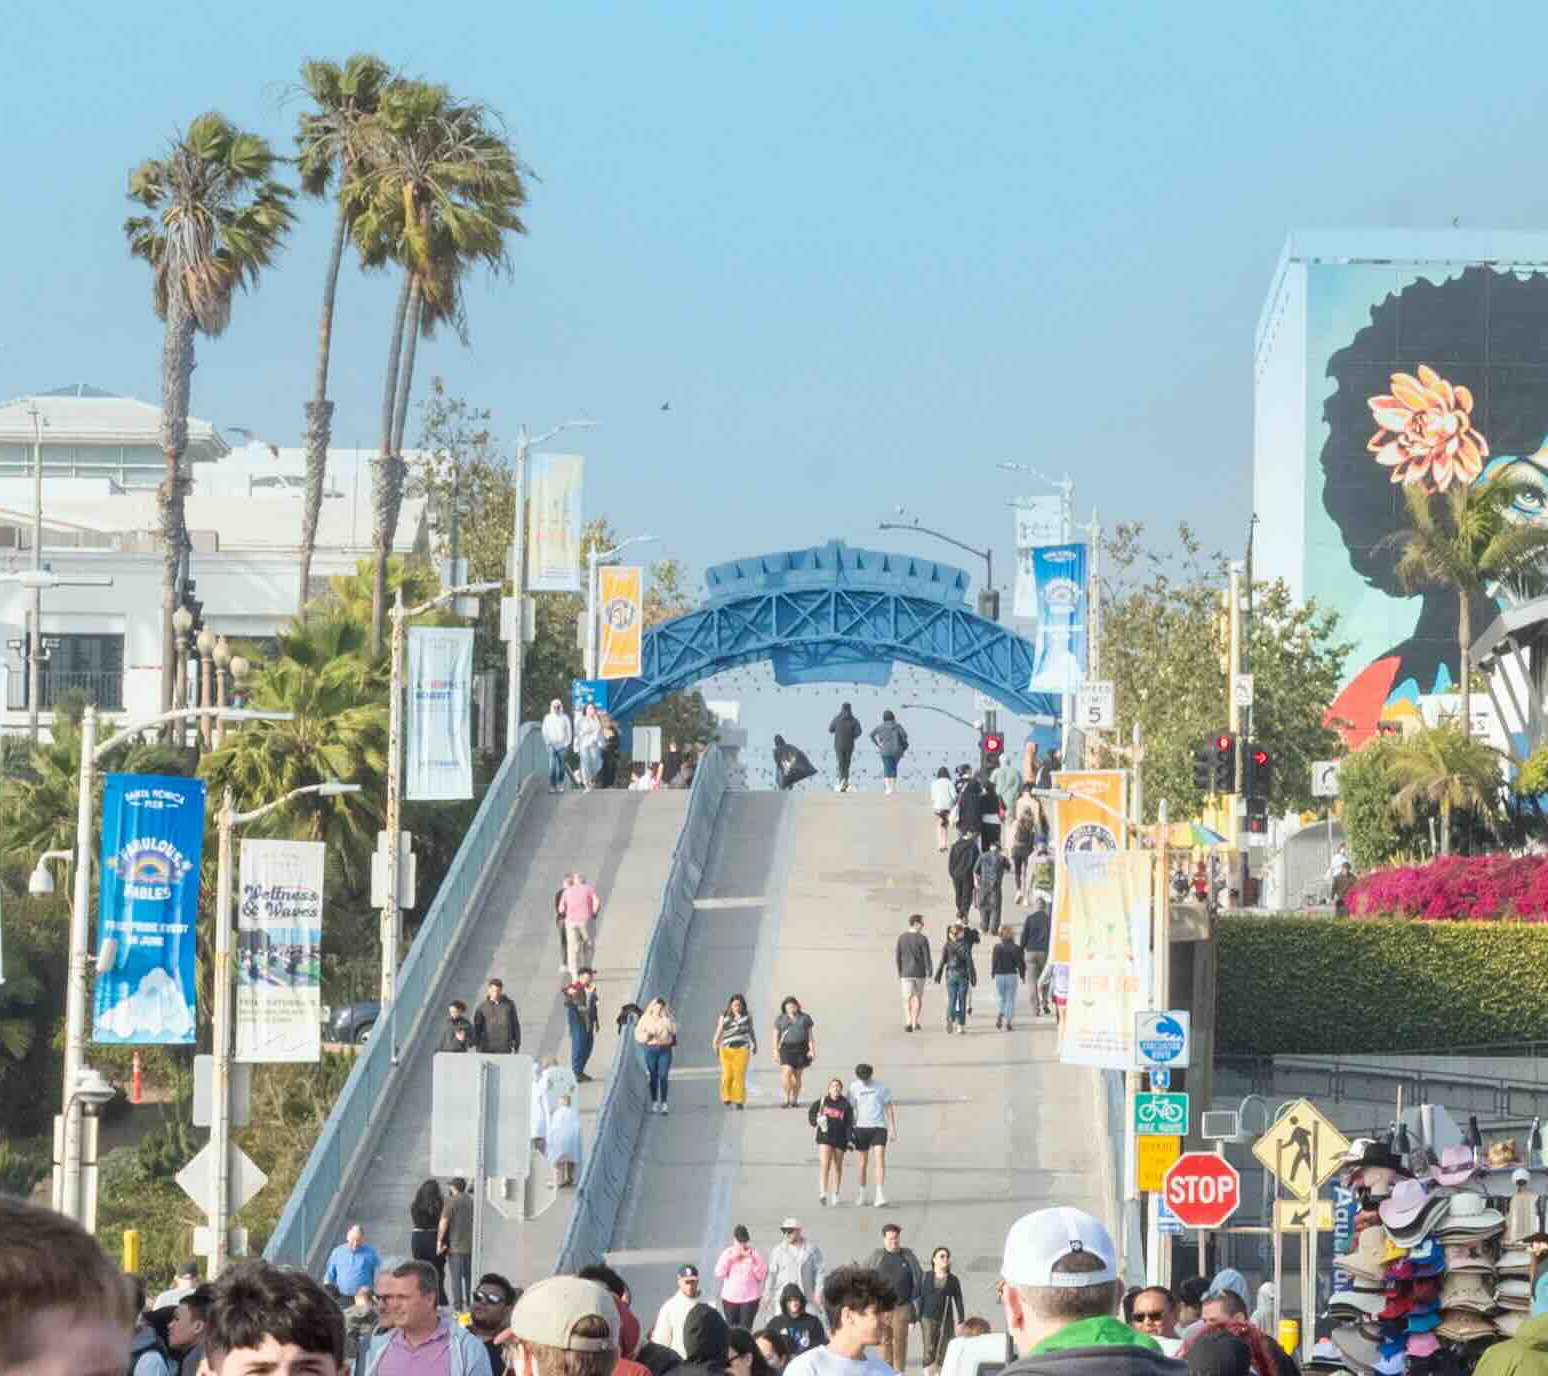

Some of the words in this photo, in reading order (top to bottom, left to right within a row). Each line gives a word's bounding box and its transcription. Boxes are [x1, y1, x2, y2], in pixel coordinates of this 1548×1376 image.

[1088, 707, 1101, 725] 5
[244, 884, 317, 902] Wellness
[265, 902, 318, 918] Waves
[1169, 1176, 1234, 1204] STOP
